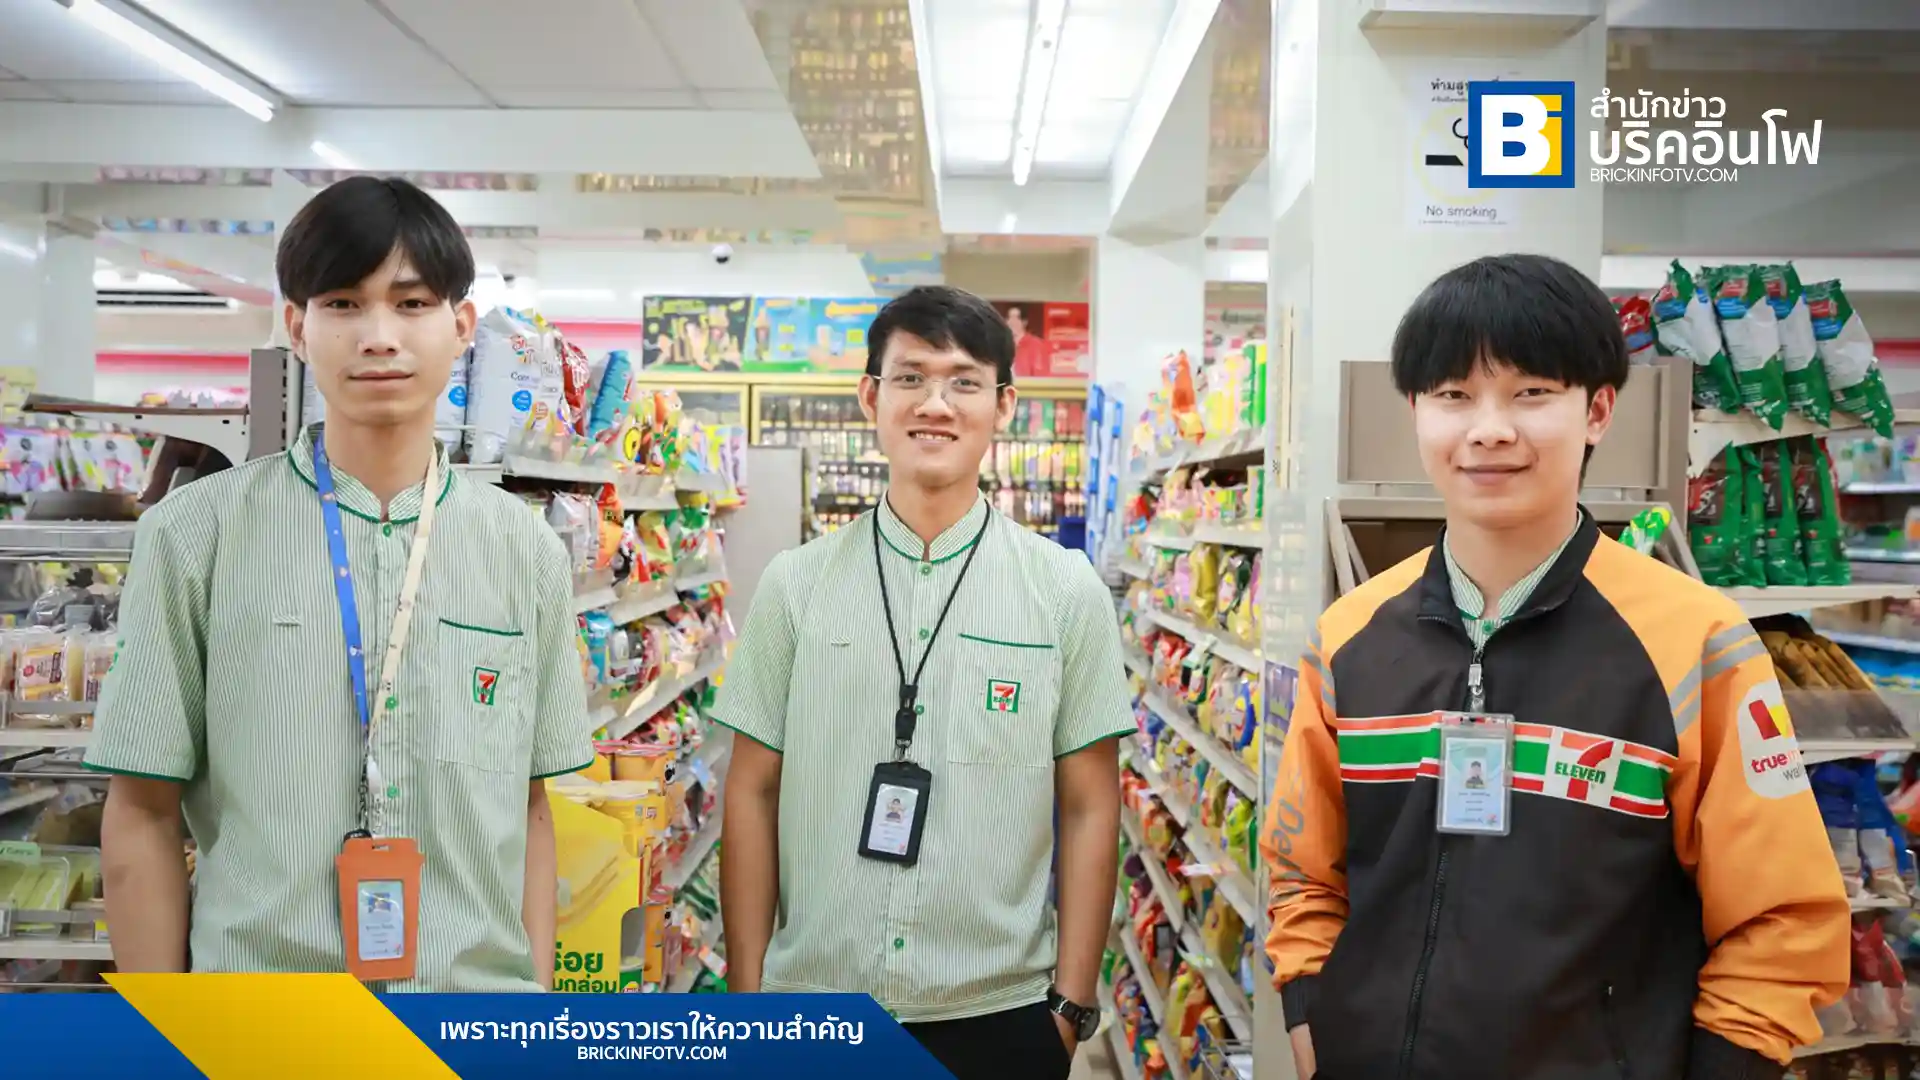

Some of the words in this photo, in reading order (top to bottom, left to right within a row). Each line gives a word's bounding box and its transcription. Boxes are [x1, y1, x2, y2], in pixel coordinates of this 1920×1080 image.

[1426, 205, 1443, 216] No
[1448, 205, 1497, 219] smoking
[554, 941, 604, 974] ร่อย
